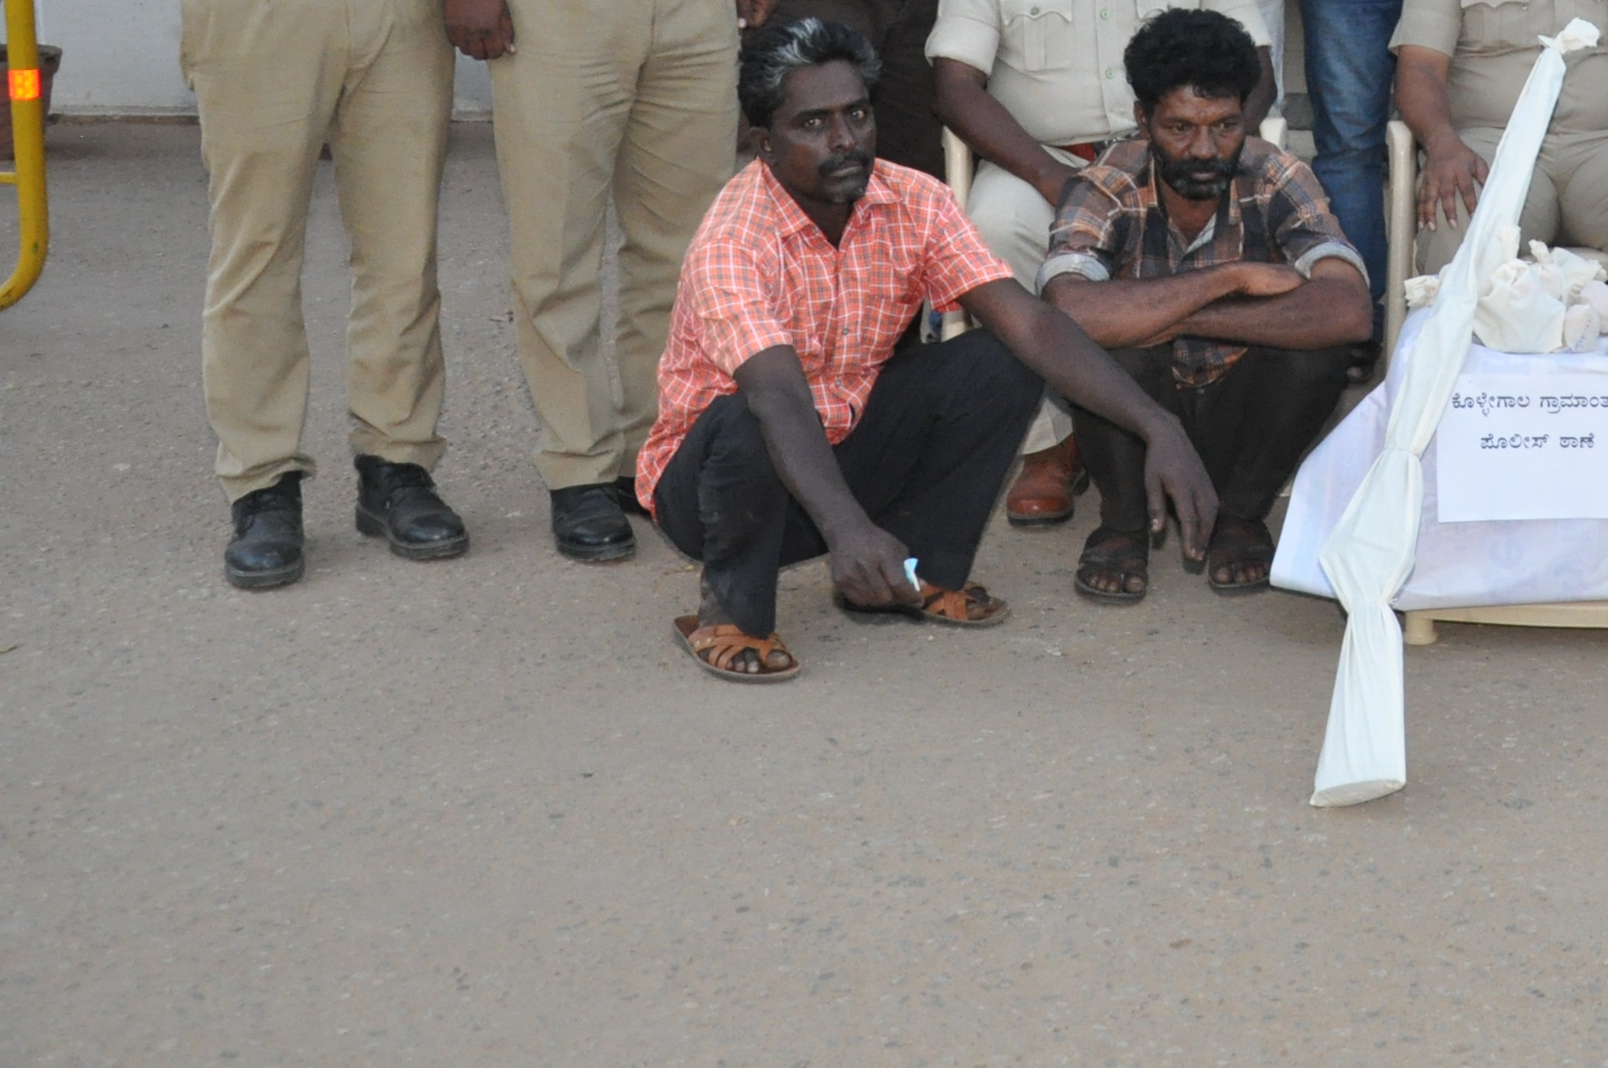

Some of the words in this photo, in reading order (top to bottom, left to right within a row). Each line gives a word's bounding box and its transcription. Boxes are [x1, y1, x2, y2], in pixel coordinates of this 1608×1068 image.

[1451, 391, 1531, 418] ಕೊಳ್ಳೇಗಾಲ
[1480, 432, 1550, 450] ಪೊಲೀಸ್
[1559, 432, 1596, 449] ಠಾಣೆ
